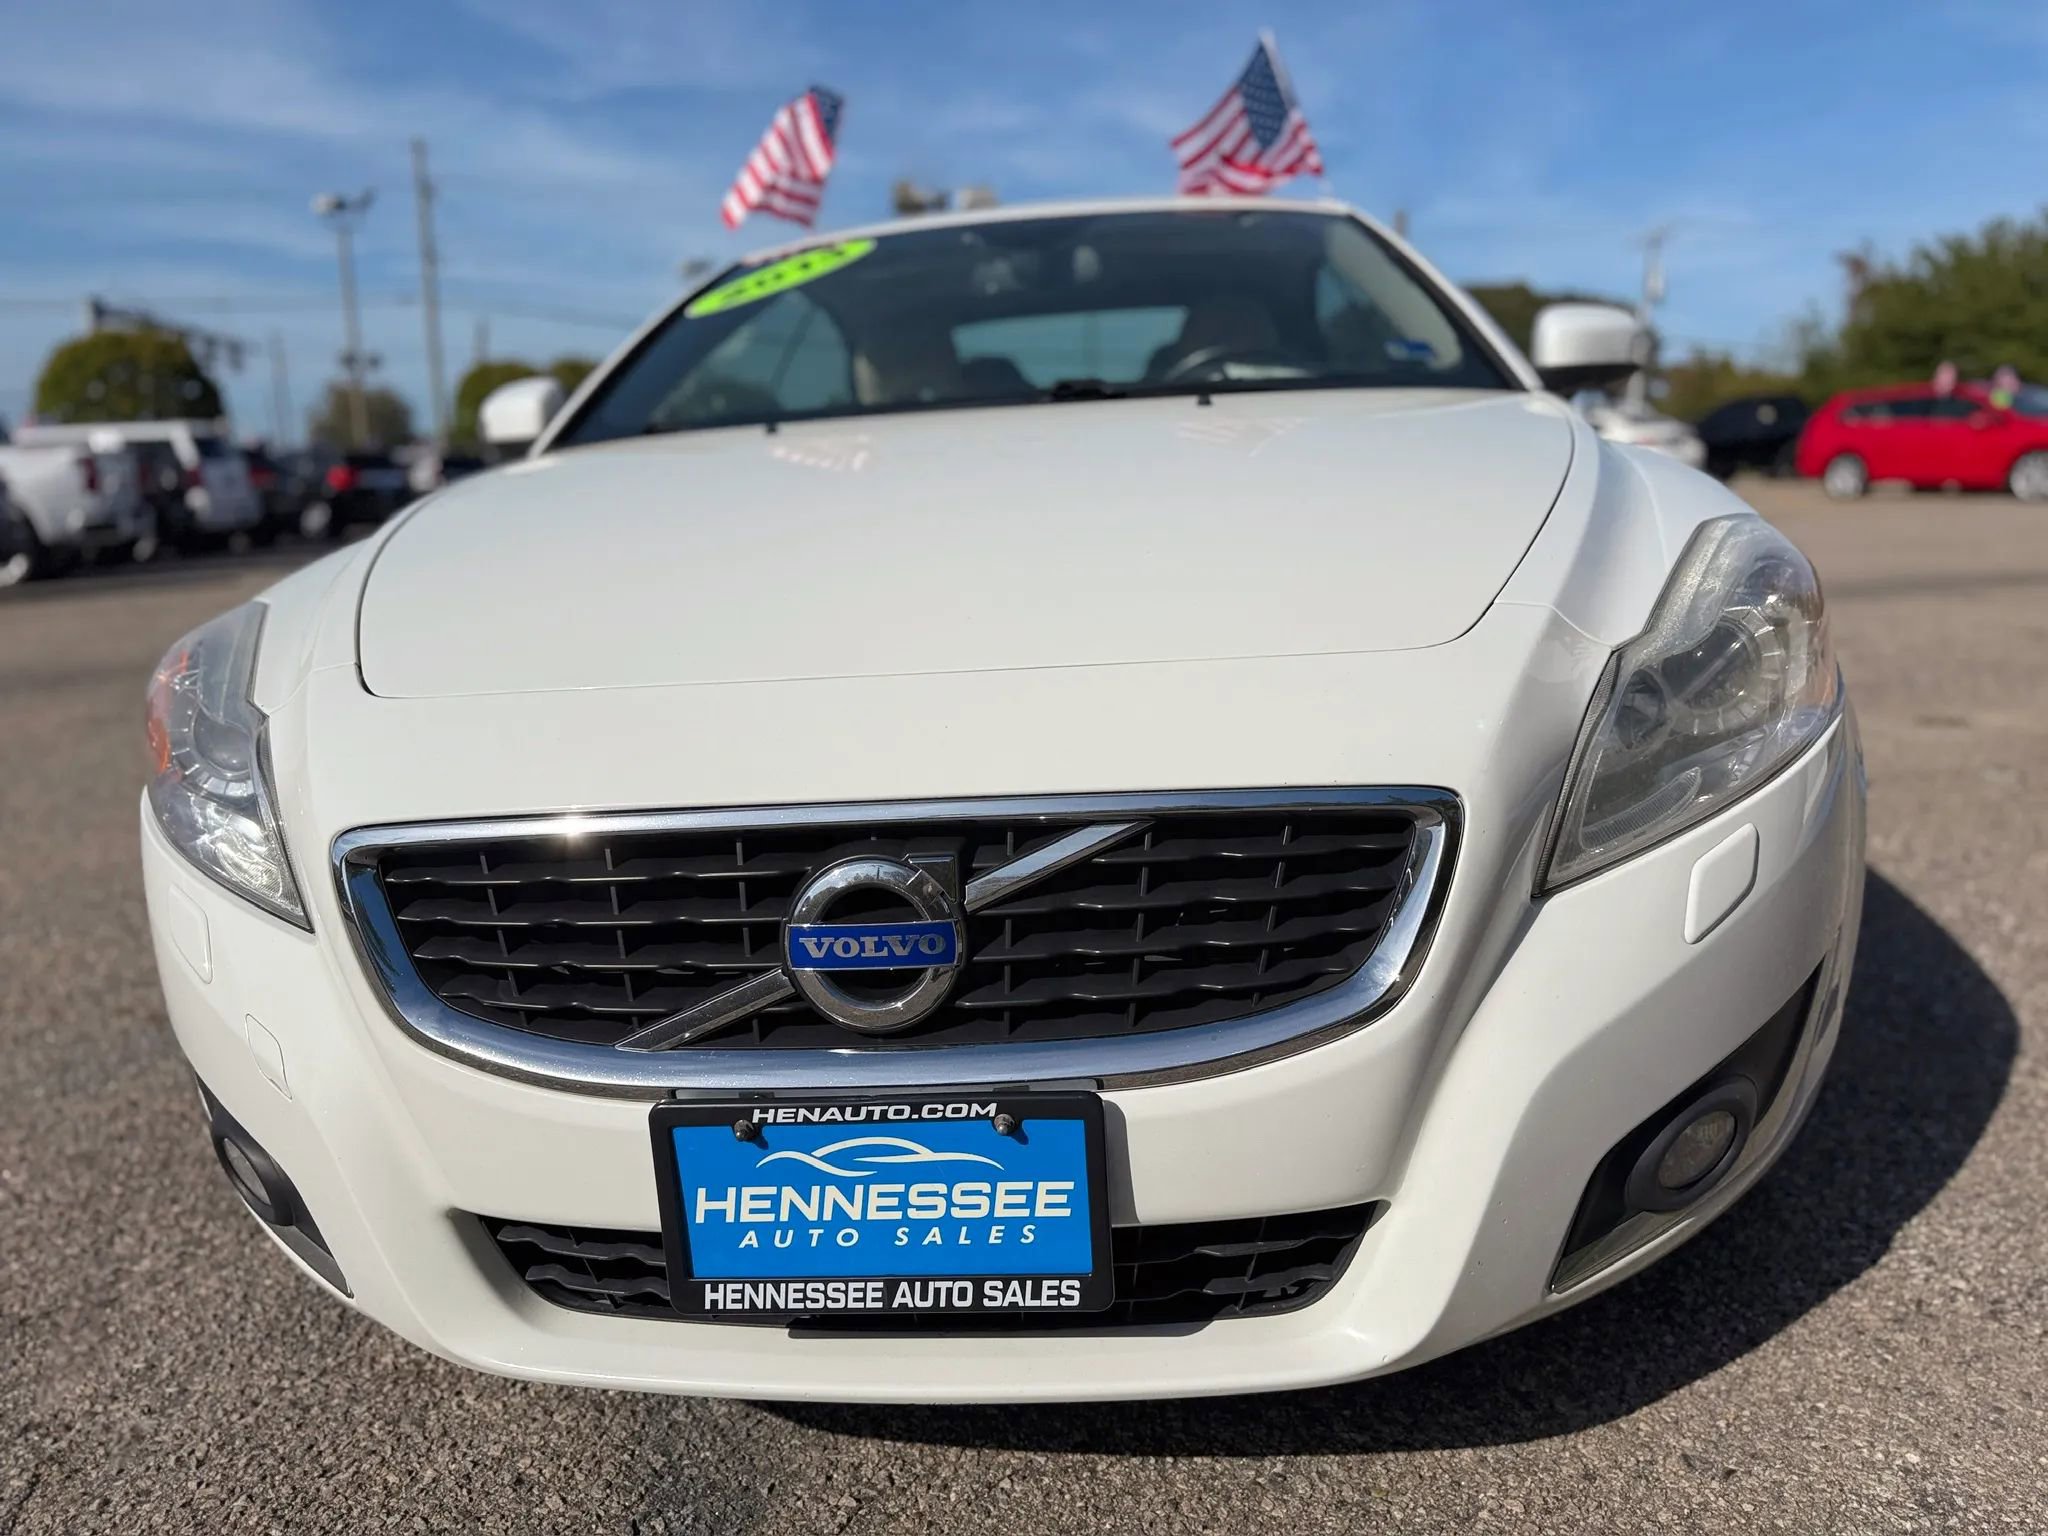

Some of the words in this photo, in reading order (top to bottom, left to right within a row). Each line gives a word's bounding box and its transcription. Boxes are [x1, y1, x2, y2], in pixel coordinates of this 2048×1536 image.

[800, 933, 946, 959] VOLVO
[751, 1103, 997, 1123] HENAUTO.COM
[696, 1182, 1074, 1223] HENNESSEE
[739, 1228, 859, 1248] AUTO
[894, 1225, 1035, 1246] SALES
[704, 1282, 883, 1310] HENNESSEE
[892, 1281, 973, 1308] AUTO
[982, 1279, 1080, 1307] SALES
